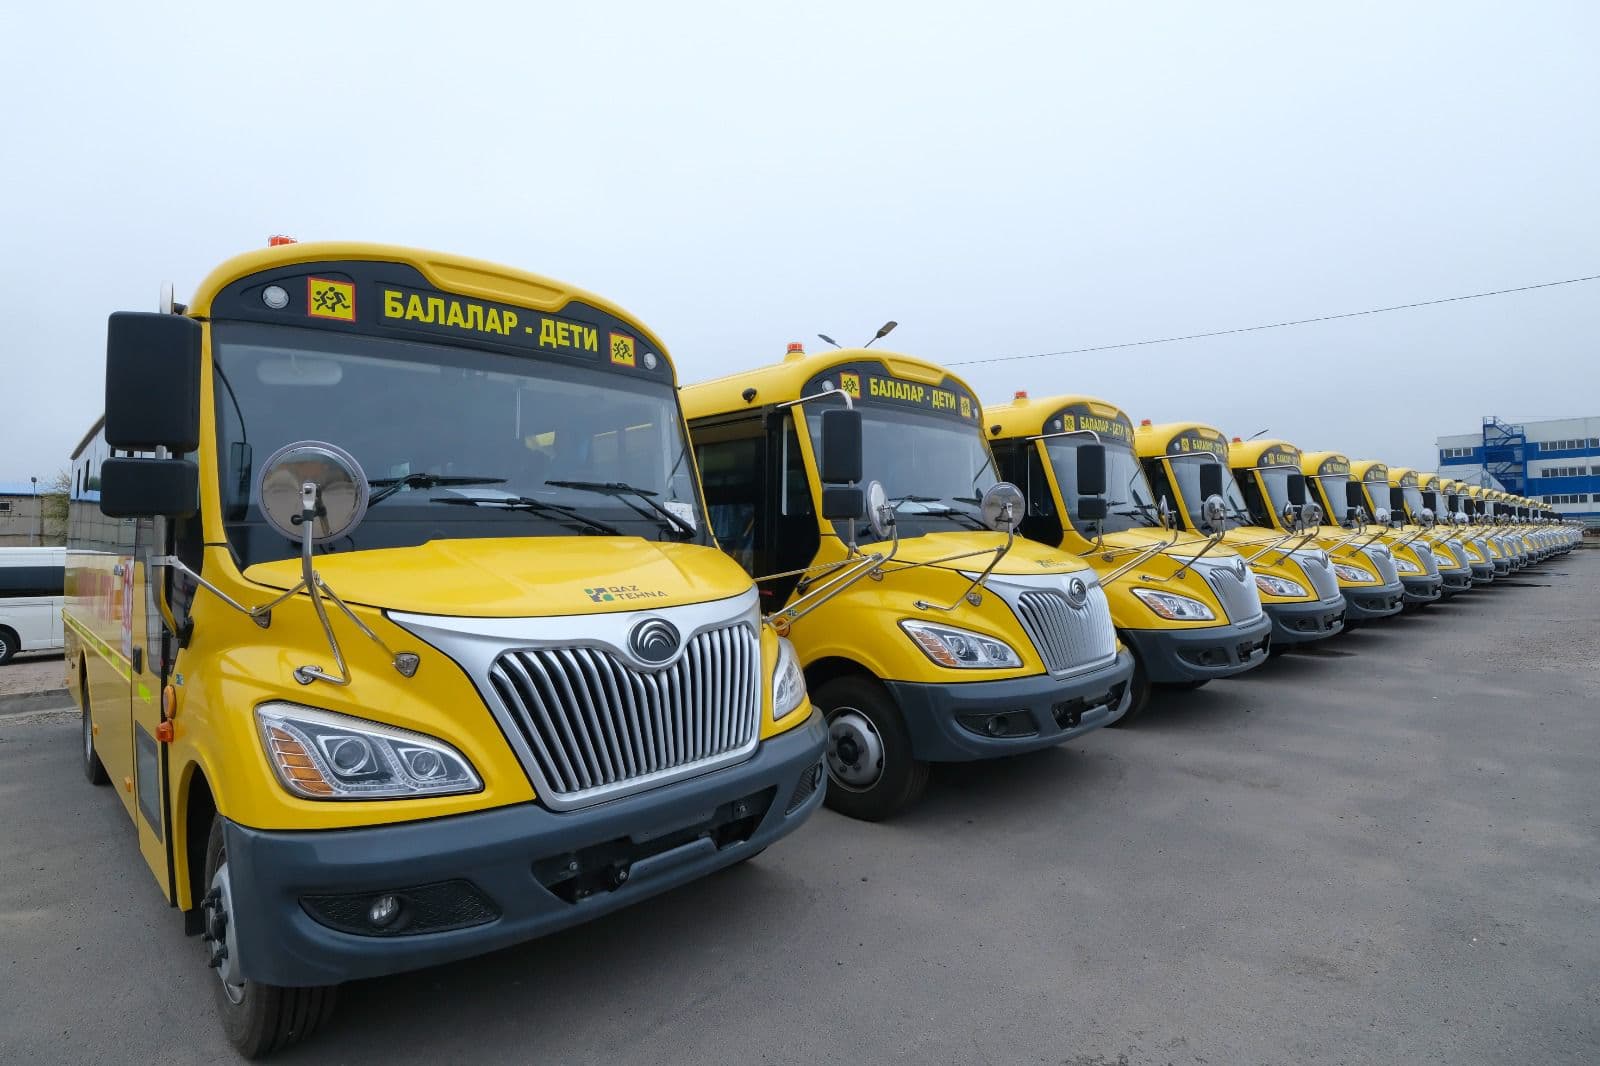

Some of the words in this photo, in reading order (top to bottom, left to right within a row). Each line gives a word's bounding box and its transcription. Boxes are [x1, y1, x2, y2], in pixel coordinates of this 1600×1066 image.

[384, 290, 518, 336] БАЛАЛАР
[539, 318, 599, 353] ДЕТИ
[869, 377, 925, 403] БАЛАЛАР
[932, 389, 956, 410] ДЕТИ
[608, 585, 639, 593] QAZ
[614, 590, 669, 600] TEHNA
